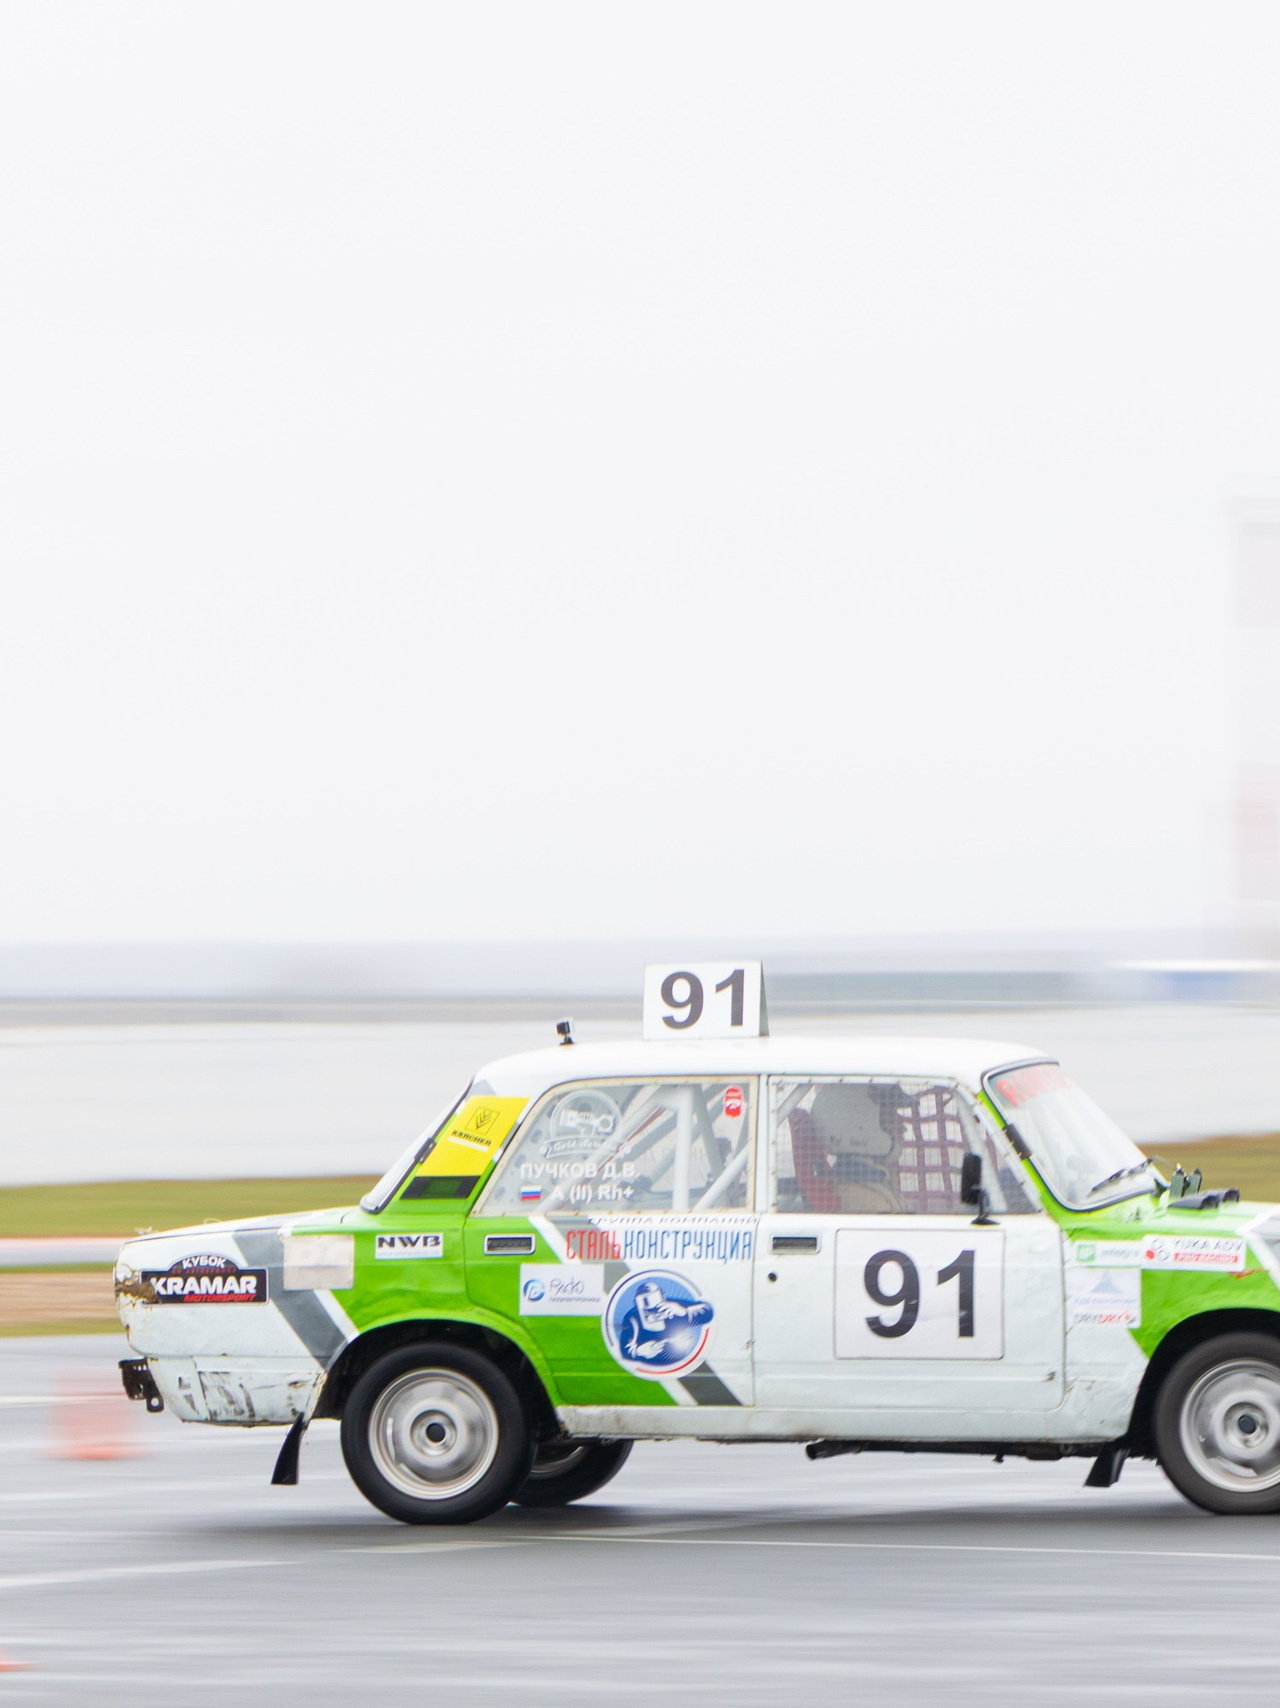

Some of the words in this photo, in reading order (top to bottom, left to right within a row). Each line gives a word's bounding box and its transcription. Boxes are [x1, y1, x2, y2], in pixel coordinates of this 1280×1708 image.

[660, 968, 745, 1029] 91
[520, 1162, 598, 1179] ПУЧКОВ
[597, 1183, 635, 1201] Rh+
[377, 1235, 441, 1248] NWB
[182, 1255, 227, 1269] КУБОК
[150, 1275, 258, 1296] KRAMAR
[863, 1249, 976, 1338] 91
[183, 1294, 257, 1303] MOTORSPORT
